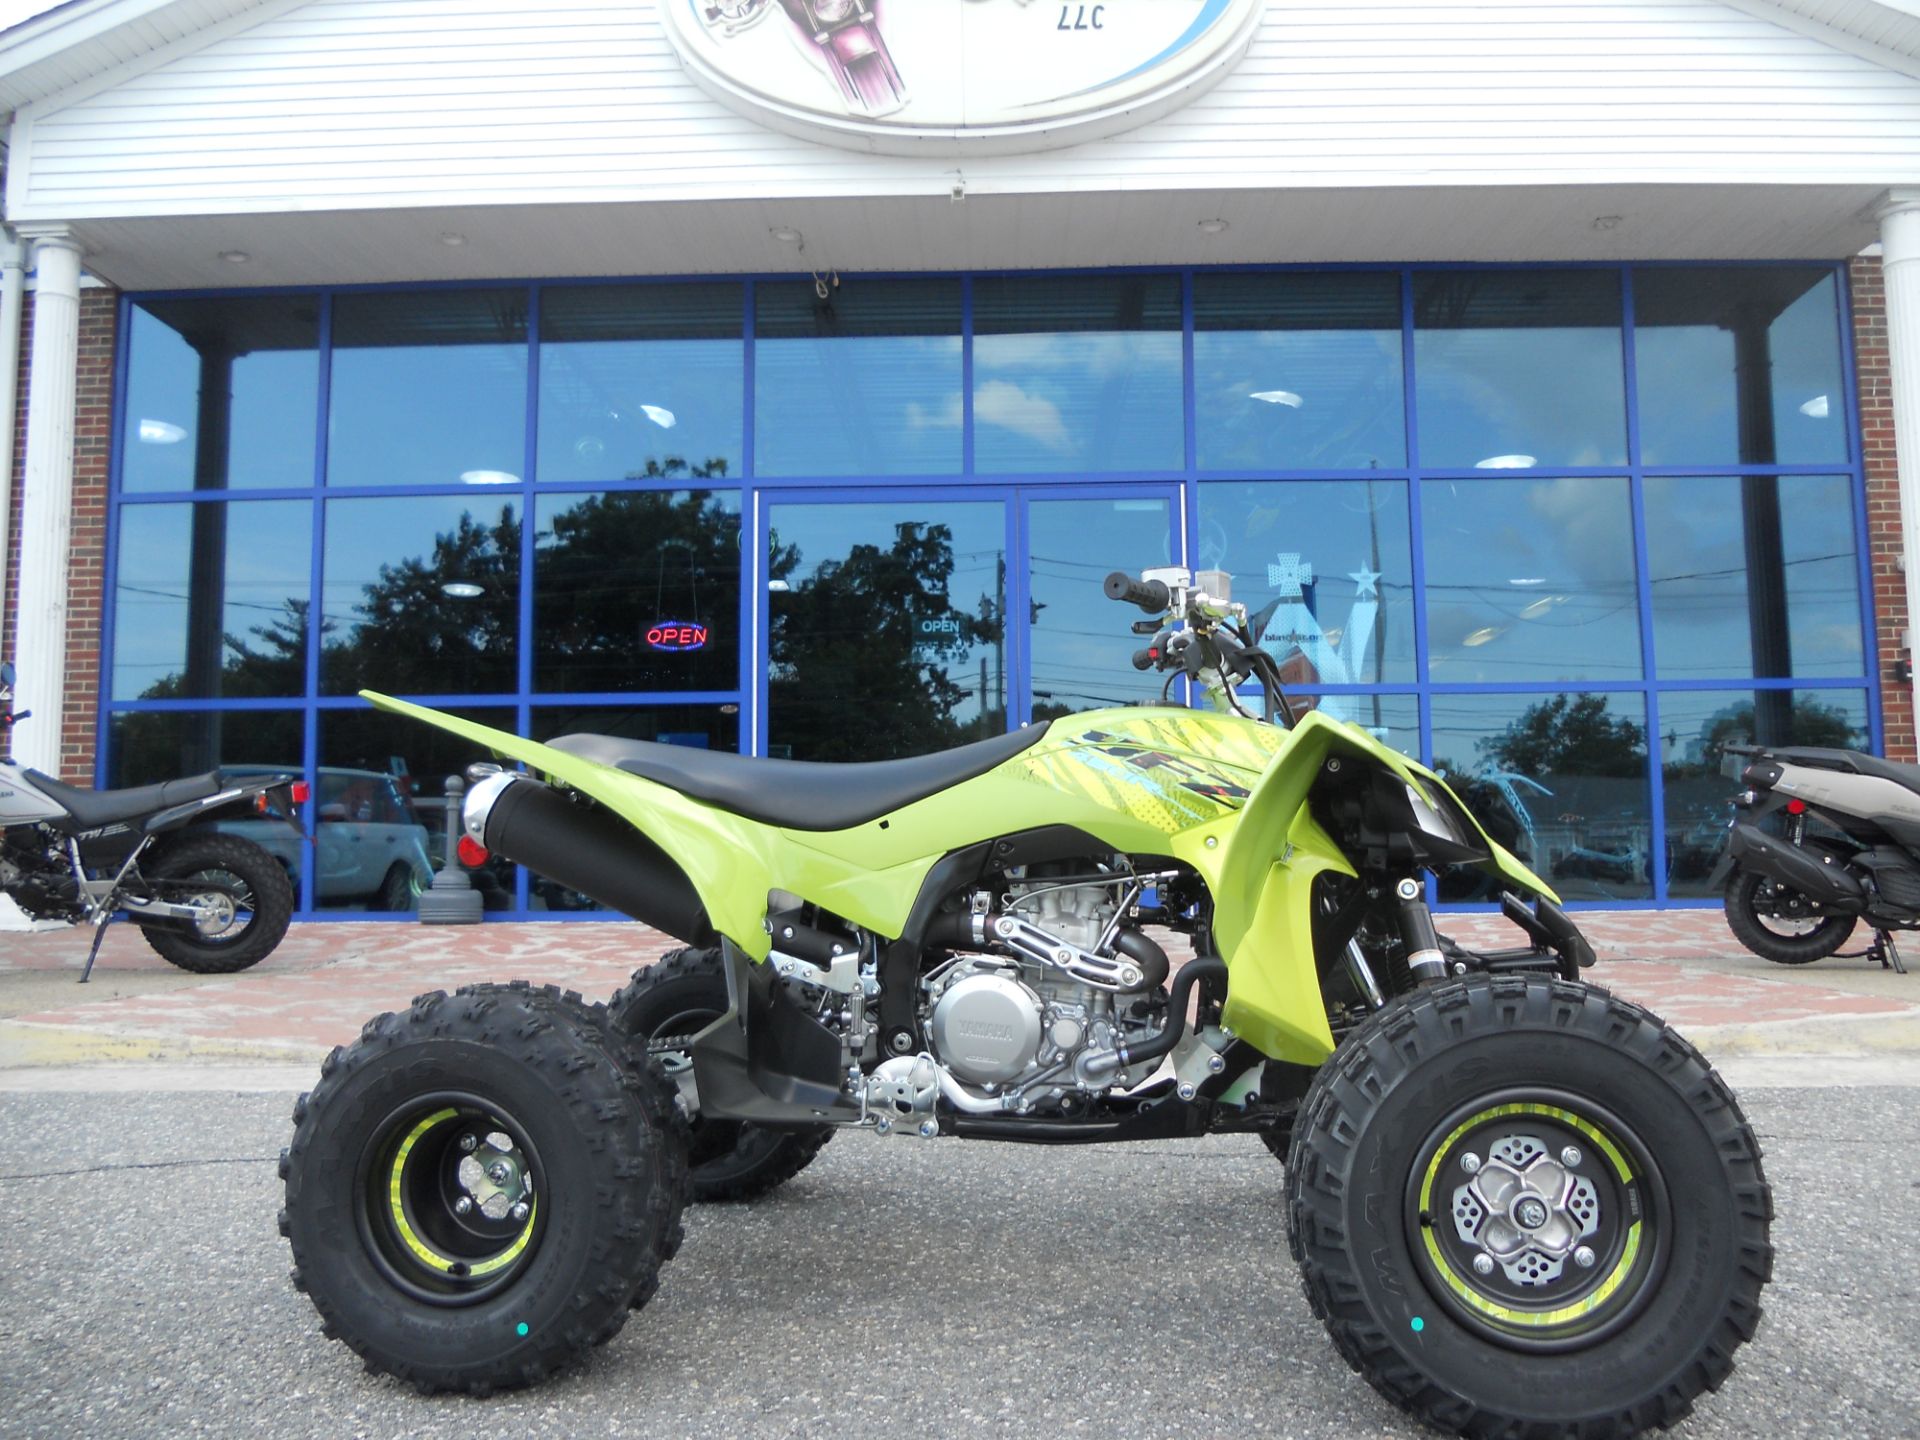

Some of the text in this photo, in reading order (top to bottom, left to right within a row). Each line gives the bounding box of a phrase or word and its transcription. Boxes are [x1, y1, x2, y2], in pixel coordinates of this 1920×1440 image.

[1057, 4, 1105, 30] LLC
[647, 627, 707, 644] OPEN
[922, 620, 960, 633] OPEN
[958, 1019, 1014, 1042] YAMAHA
